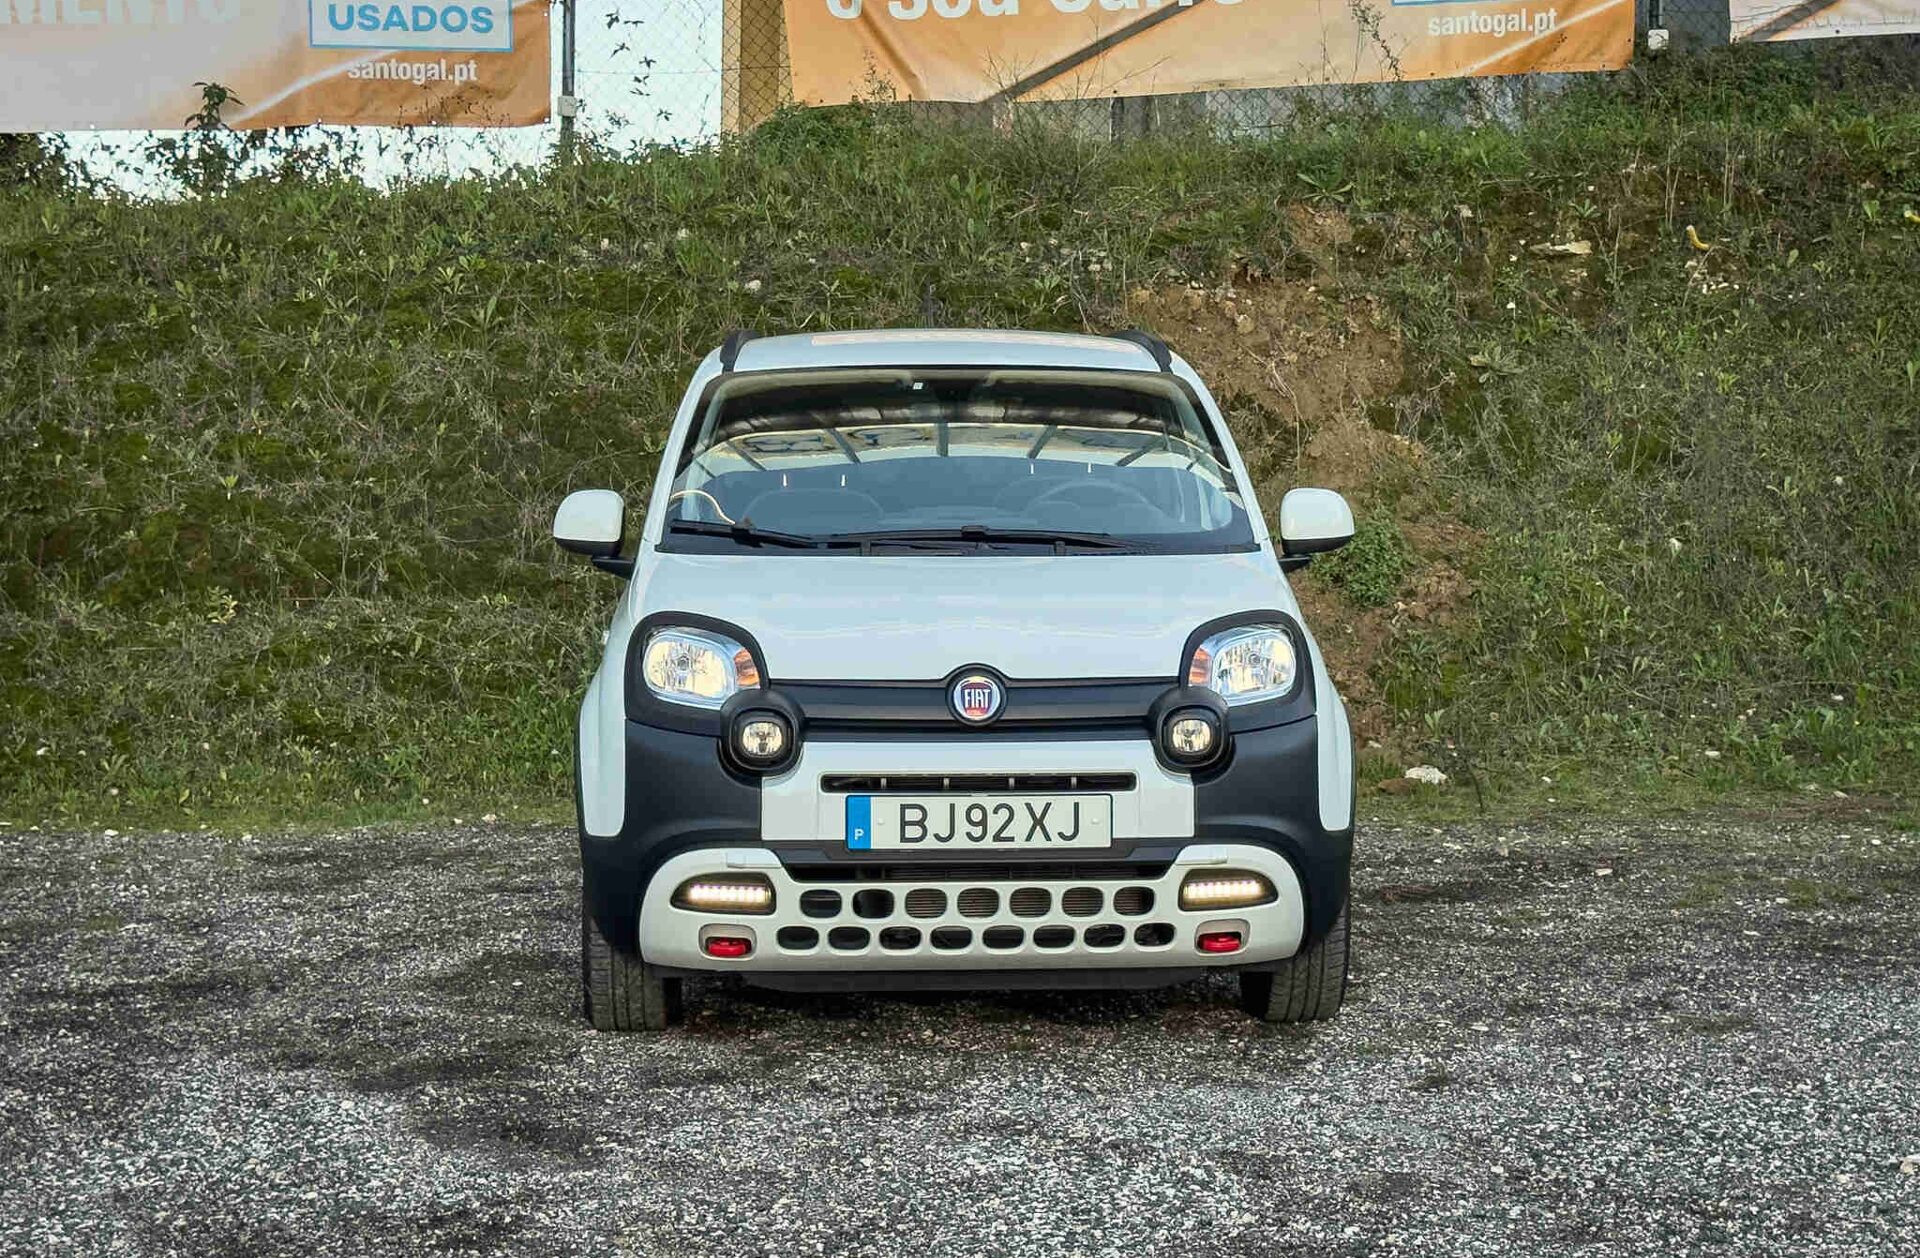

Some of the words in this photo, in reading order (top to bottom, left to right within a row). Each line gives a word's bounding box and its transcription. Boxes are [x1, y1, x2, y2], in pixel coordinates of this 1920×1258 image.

[328, 4, 494, 33] USADOS
[1428, 8, 1558, 37] santogal.pt
[348, 58, 478, 85] santogal.pt
[964, 688, 991, 708] FIAT
[854, 828, 865, 841] P
